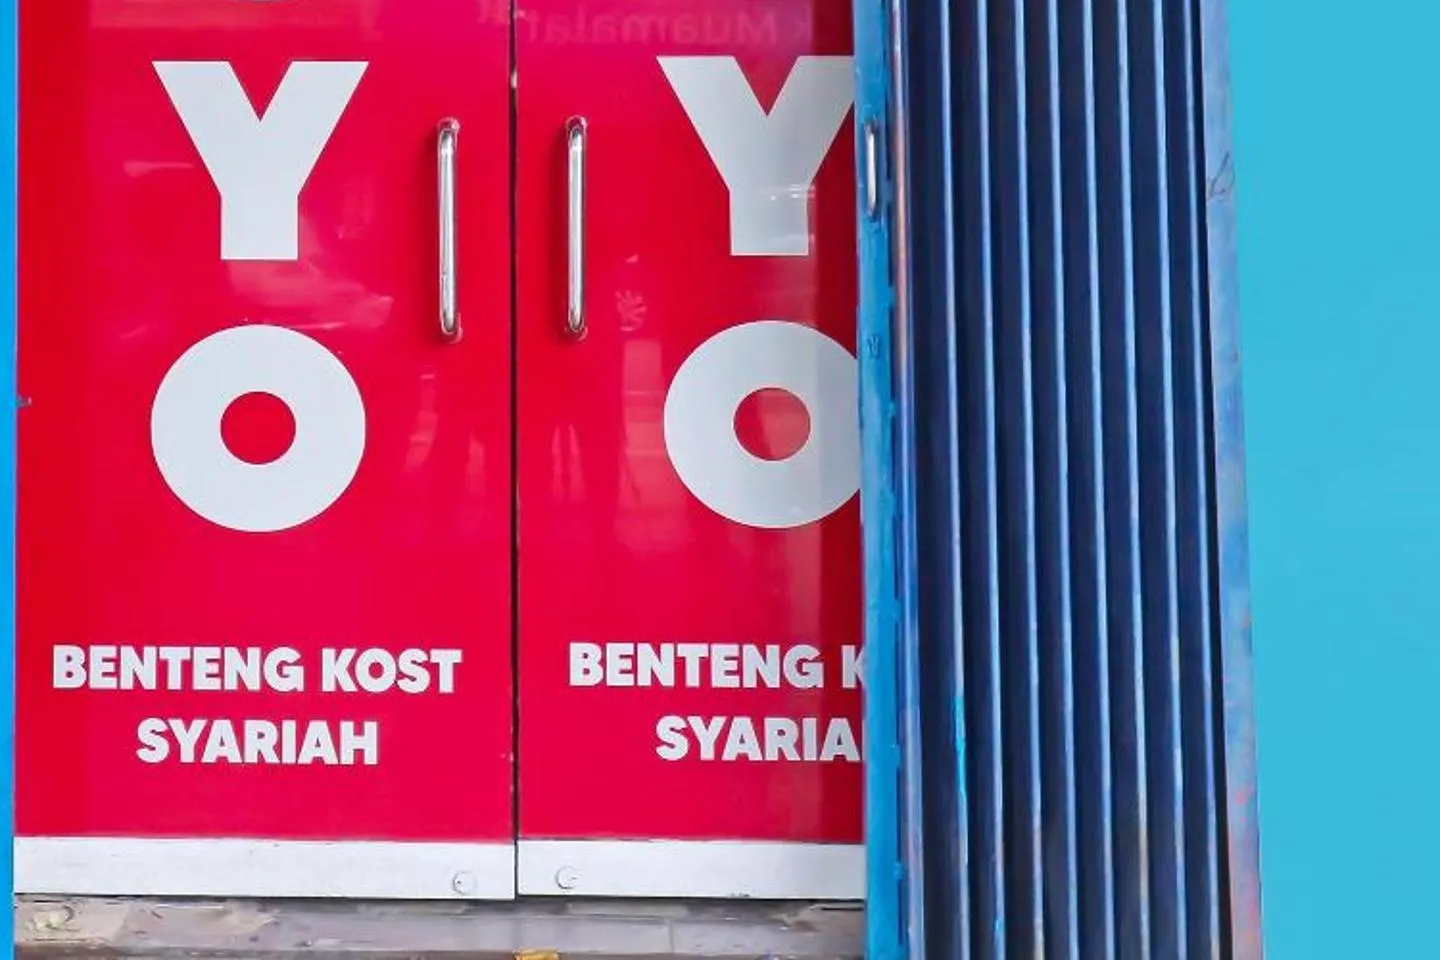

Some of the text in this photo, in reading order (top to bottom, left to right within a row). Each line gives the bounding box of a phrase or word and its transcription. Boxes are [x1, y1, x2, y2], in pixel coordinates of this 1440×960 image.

[53, 645, 462, 693] BENTENG KOST
[570, 643, 823, 688] BENTENG
[137, 718, 377, 764] SYARIAH
[656, 716, 865, 761] SYARIA
